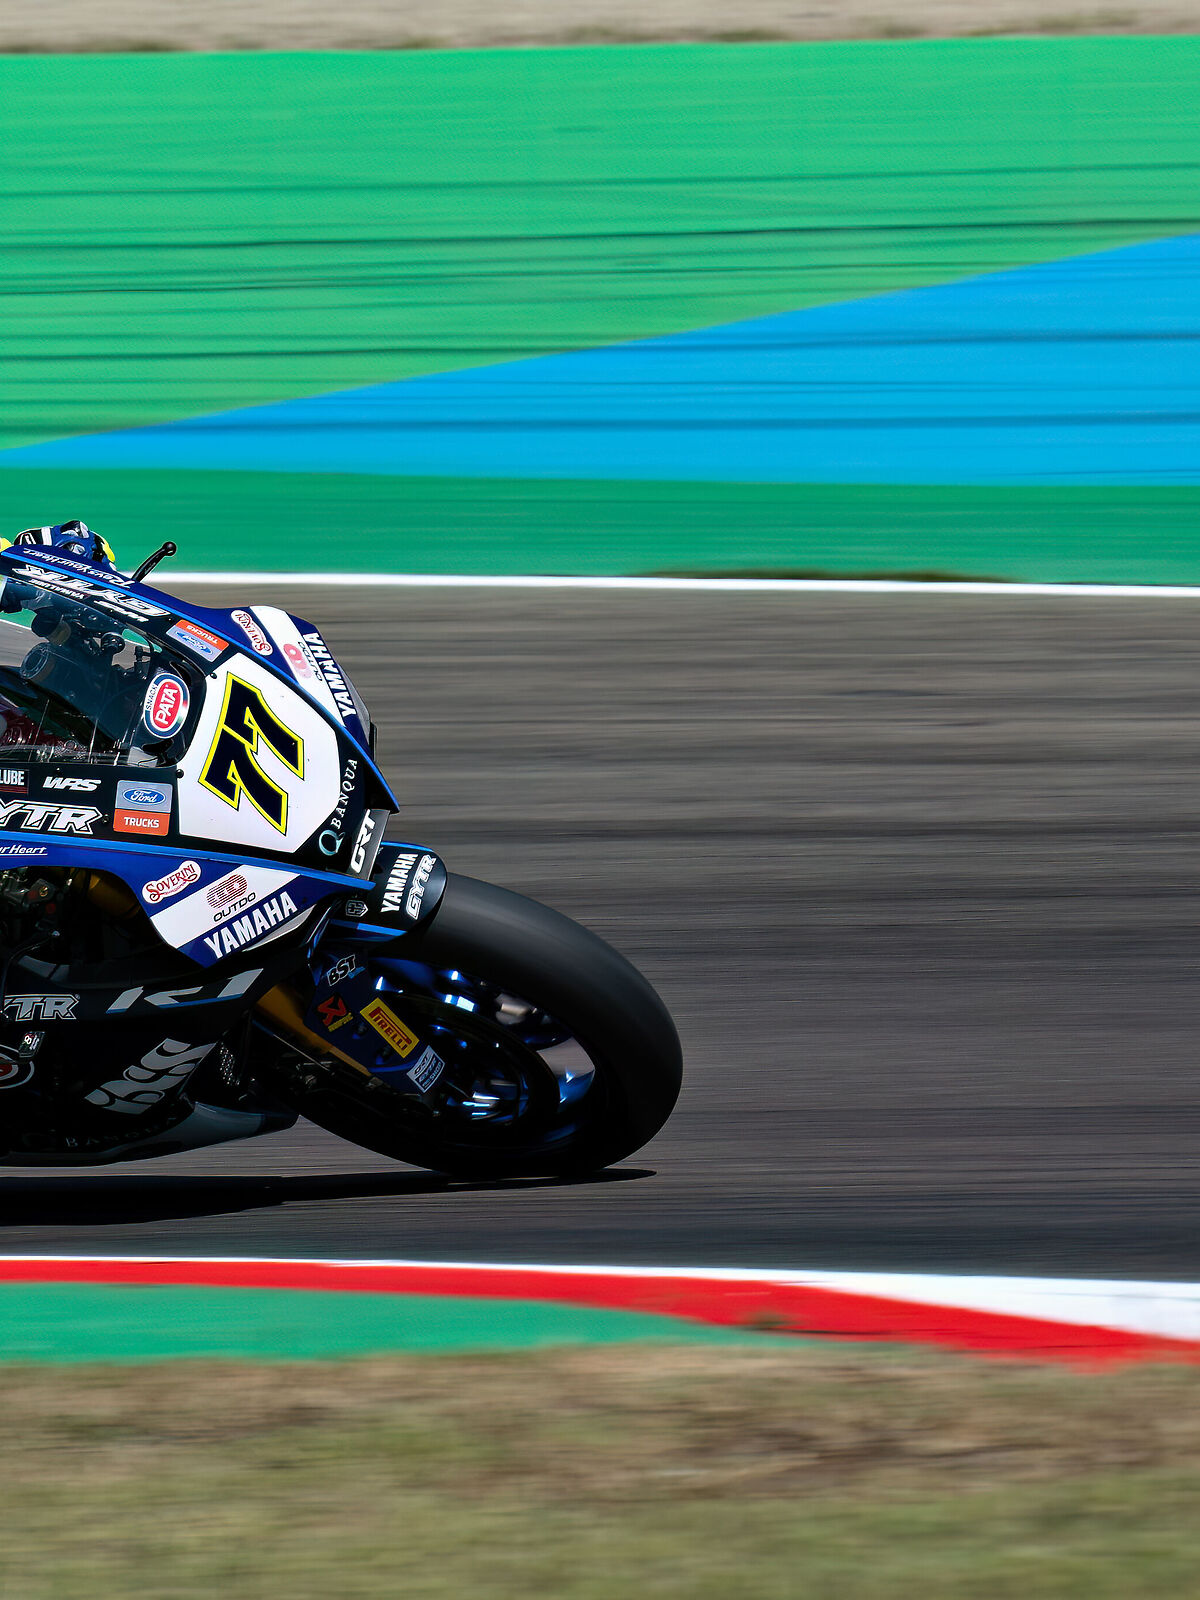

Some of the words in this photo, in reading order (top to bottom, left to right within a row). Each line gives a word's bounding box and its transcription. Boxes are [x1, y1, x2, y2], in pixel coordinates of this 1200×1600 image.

[186, 624, 219, 645] TRUCKS
[302, 632, 358, 718] YAMAHA
[145, 683, 158, 712] SNACK
[155, 685, 185, 726] PATA
[199, 671, 305, 837] 77
[128, 790, 160, 804] Ford
[330, 759, 358, 829] BANQUA
[123, 816, 160, 830] TRUCKS
[351, 808, 376, 874] GRT
[146, 864, 198, 902] SOVERINI
[380, 853, 419, 913] YAMAHA
[406, 854, 437, 920] GYTR
[203, 891, 298, 959] YAMAHA
[213, 892, 256, 922] OUTDO
[327, 954, 356, 986] BST
[368, 1006, 413, 1051] PIRELLI
